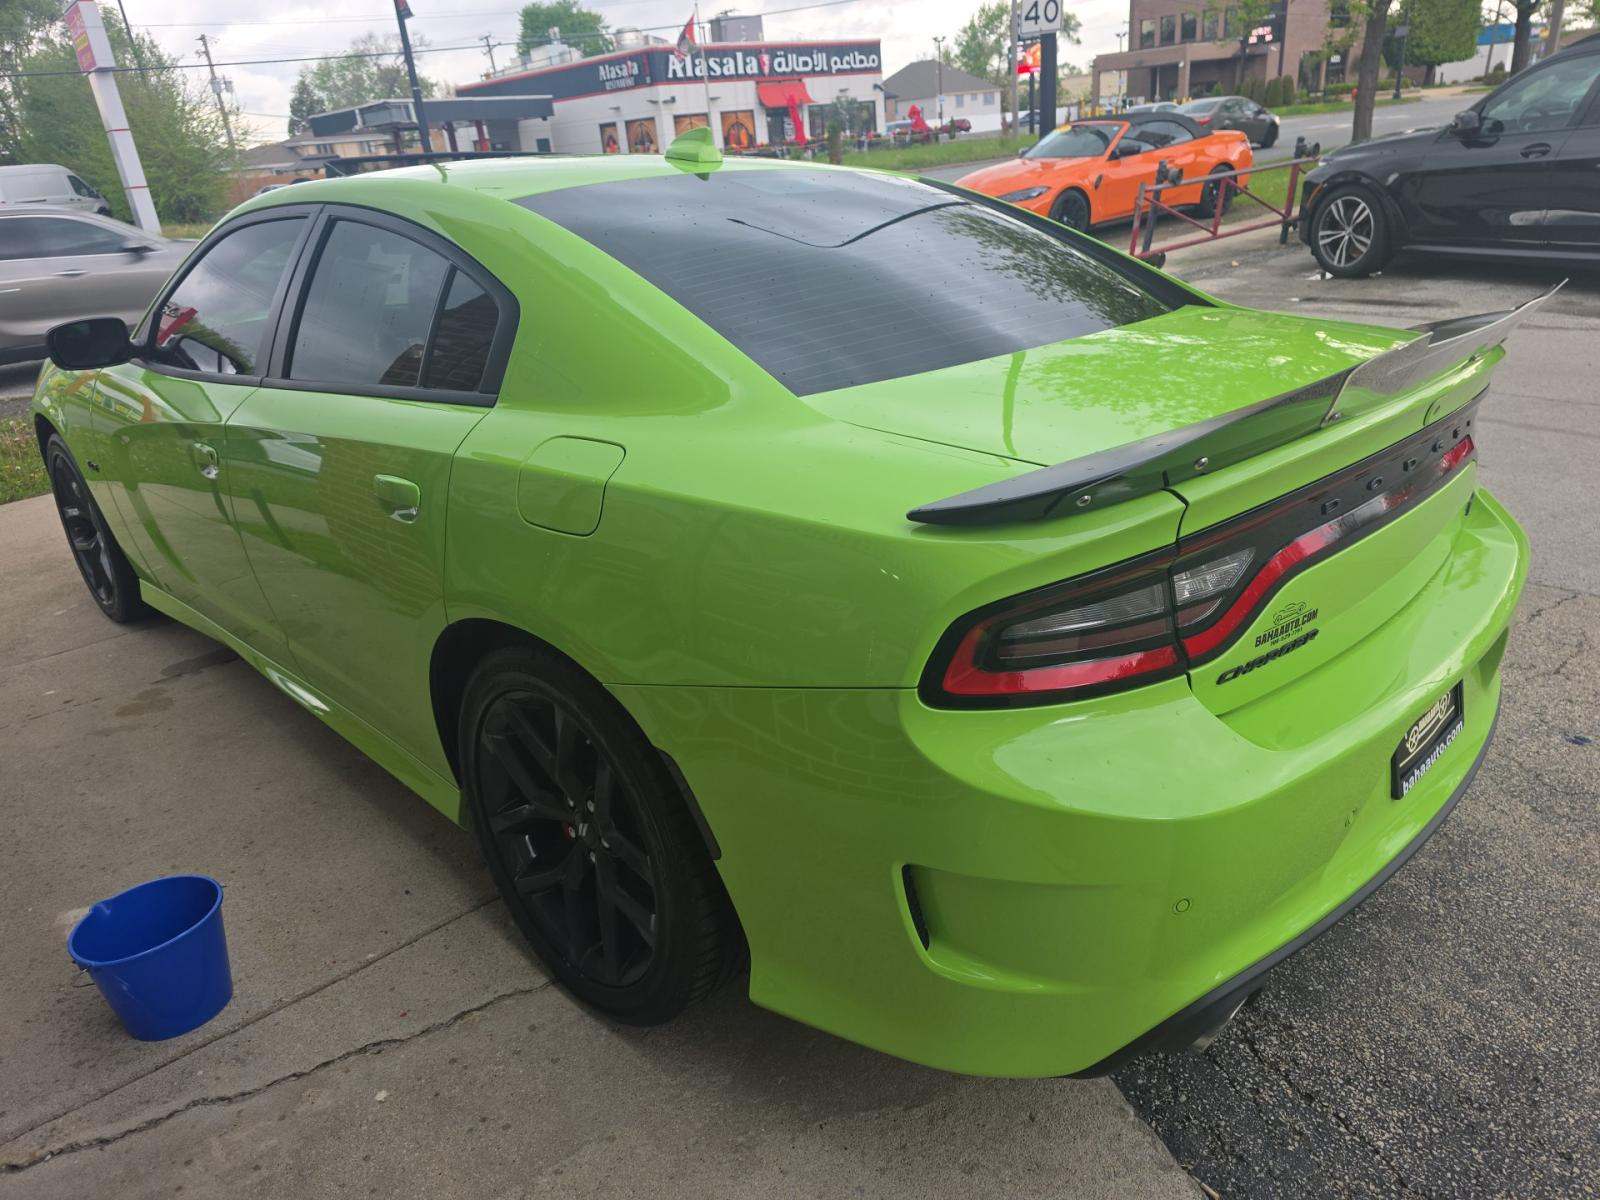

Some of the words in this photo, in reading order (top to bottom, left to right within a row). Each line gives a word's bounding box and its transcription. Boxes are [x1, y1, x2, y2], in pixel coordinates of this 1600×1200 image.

[1024, 0, 1059, 25] 40
[667, 52, 759, 78] Alasala
[773, 49, 828, 73] الأصالة
[830, 51, 879, 74] مطاعم
[1255, 608, 1319, 648] BAHAAUTO.COM
[1402, 720, 1463, 796] bahaauto.com
